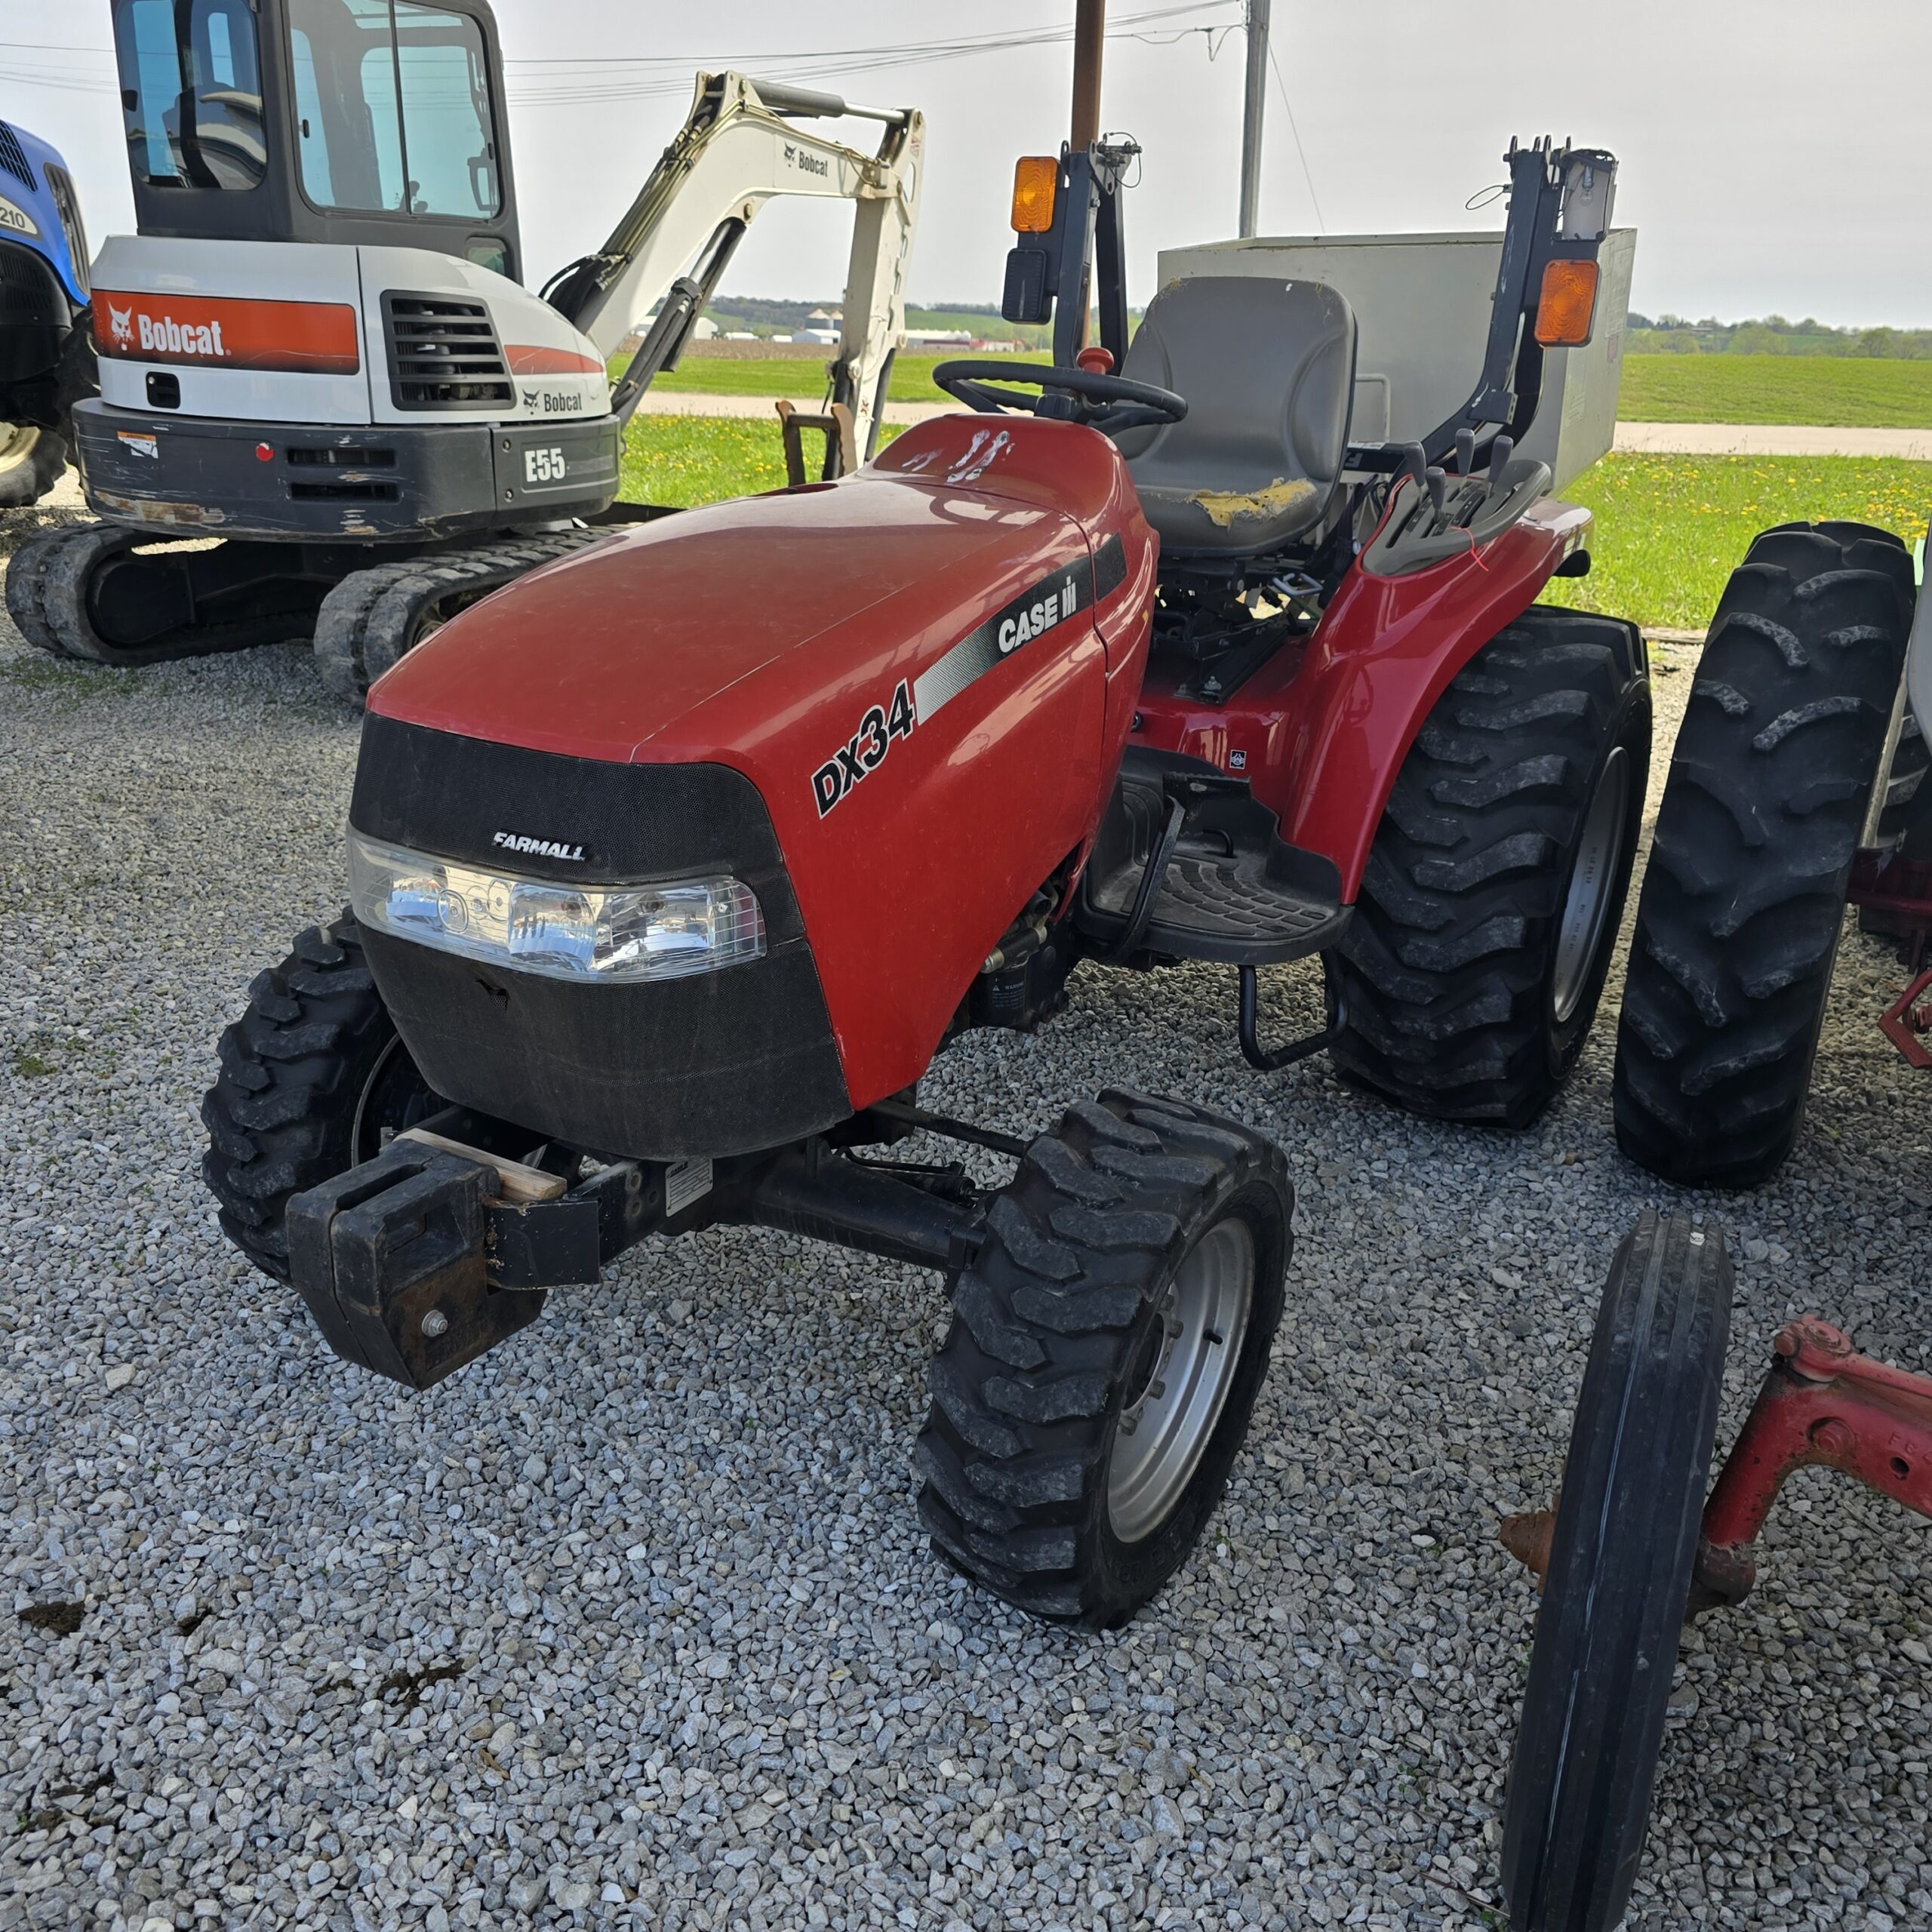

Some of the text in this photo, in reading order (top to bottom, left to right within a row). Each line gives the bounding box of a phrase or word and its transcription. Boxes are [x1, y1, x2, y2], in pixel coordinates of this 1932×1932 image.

[798, 150, 827, 177] Bobcat
[0, 206, 26, 228] 210
[137, 314, 224, 356] Bobcat
[543, 392, 583, 412] Bobcat
[525, 448, 566, 482] E55
[998, 592, 1057, 653] CASE
[811, 677, 916, 820] DX34
[491, 832, 586, 861] FARMALL
